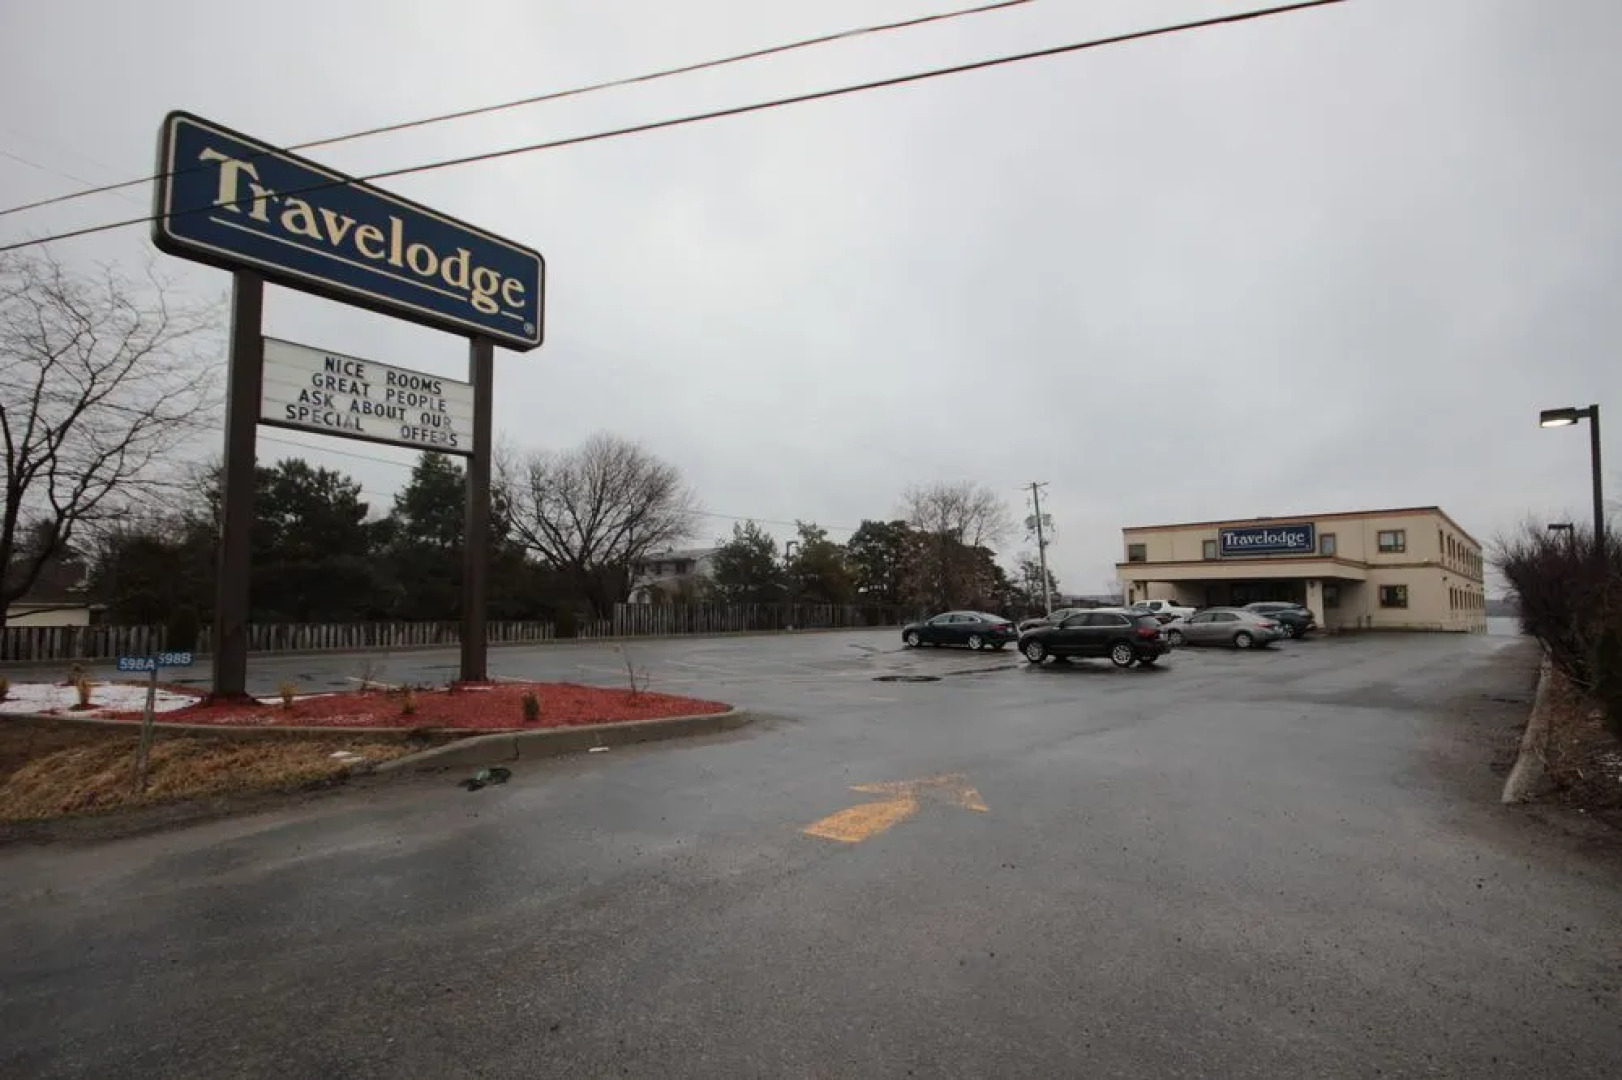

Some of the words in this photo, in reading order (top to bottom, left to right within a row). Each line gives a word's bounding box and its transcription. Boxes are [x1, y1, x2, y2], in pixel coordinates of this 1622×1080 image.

[199, 147, 525, 314] Travelodge
[312, 372, 370, 397] GREAT
[386, 388, 446, 413] PEOPLE
[324, 356, 365, 378] NICE
[387, 370, 442, 395] ROOMS
[286, 404, 364, 432] SPECIAL
[401, 425, 458, 447] OFFERS
[298, 389, 334, 409] ASK
[350, 399, 406, 421] ABOUT
[421, 413, 452, 429] OUR
[1224, 530, 1305, 547] Travelodge
